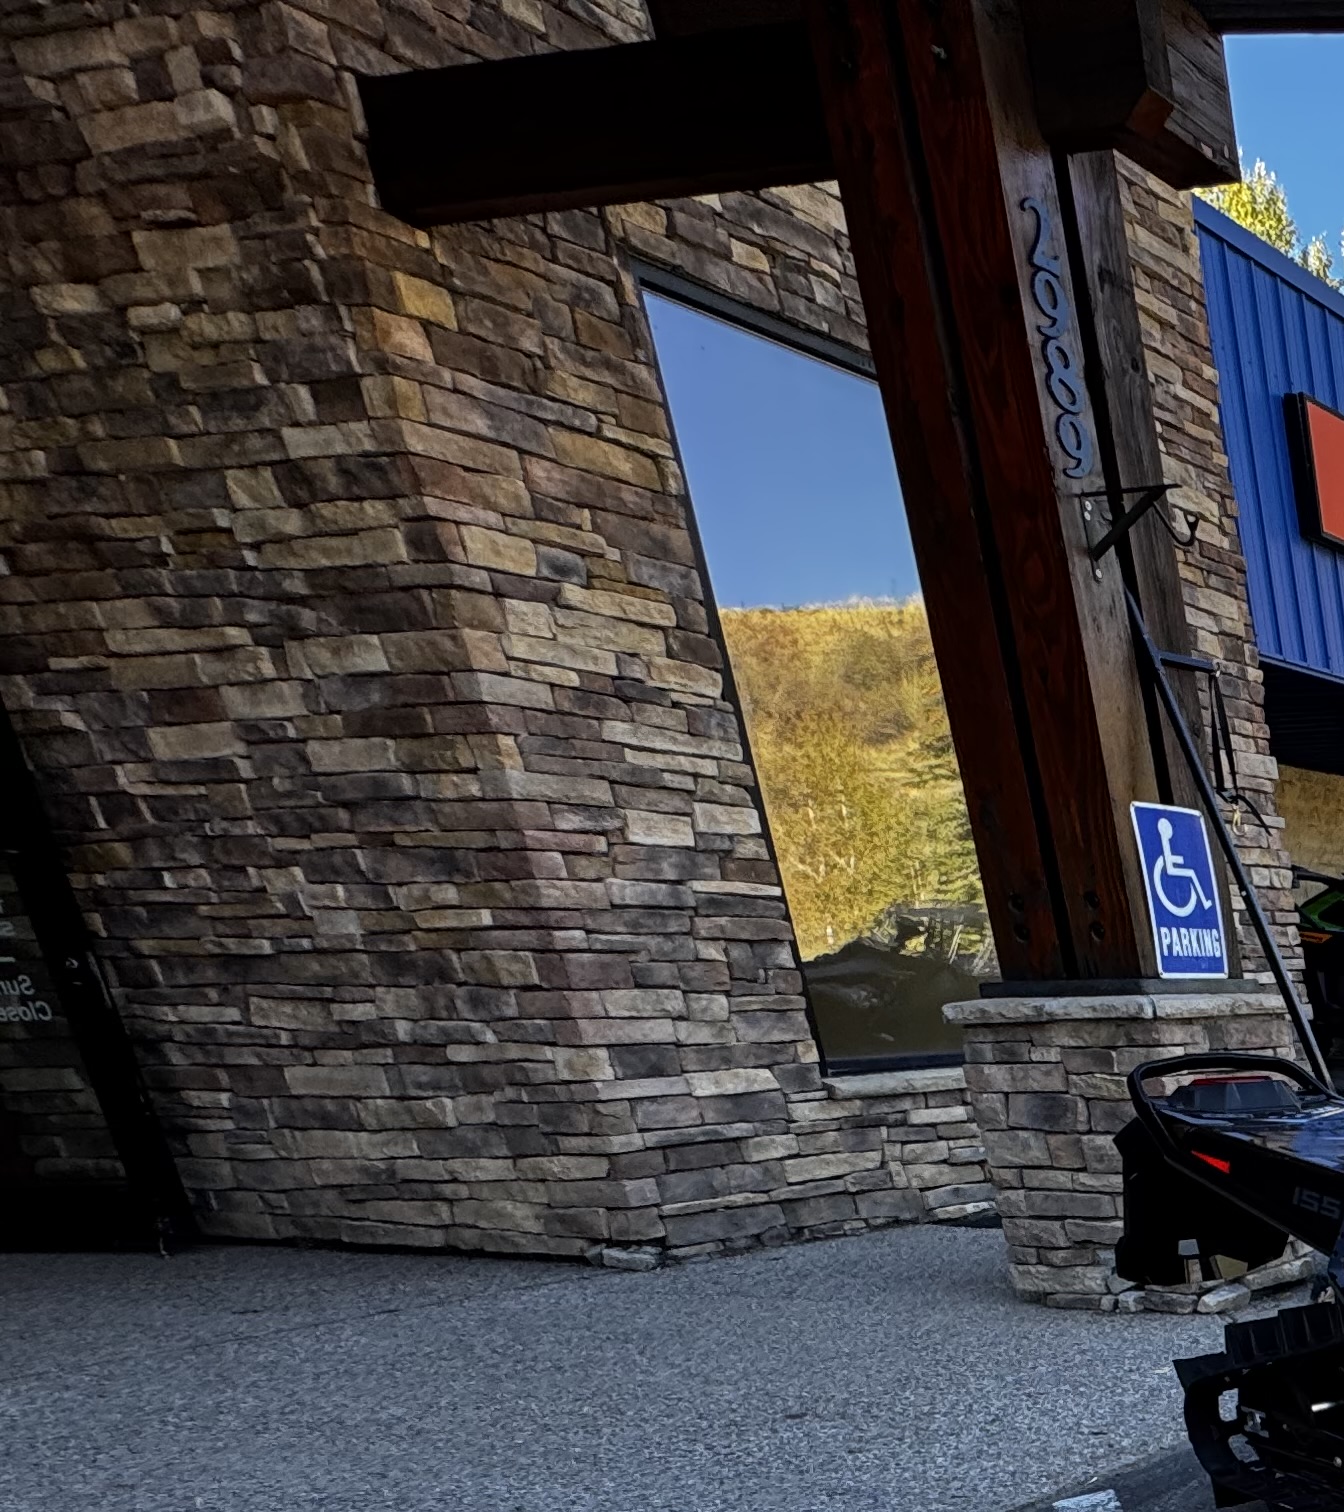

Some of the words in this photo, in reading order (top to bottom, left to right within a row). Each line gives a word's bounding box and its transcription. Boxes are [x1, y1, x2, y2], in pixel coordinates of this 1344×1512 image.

[1020, 197, 1094, 479] 2989
[1160, 926, 1221, 958] PARKING
[1291, 1184, 1341, 1220] 155
